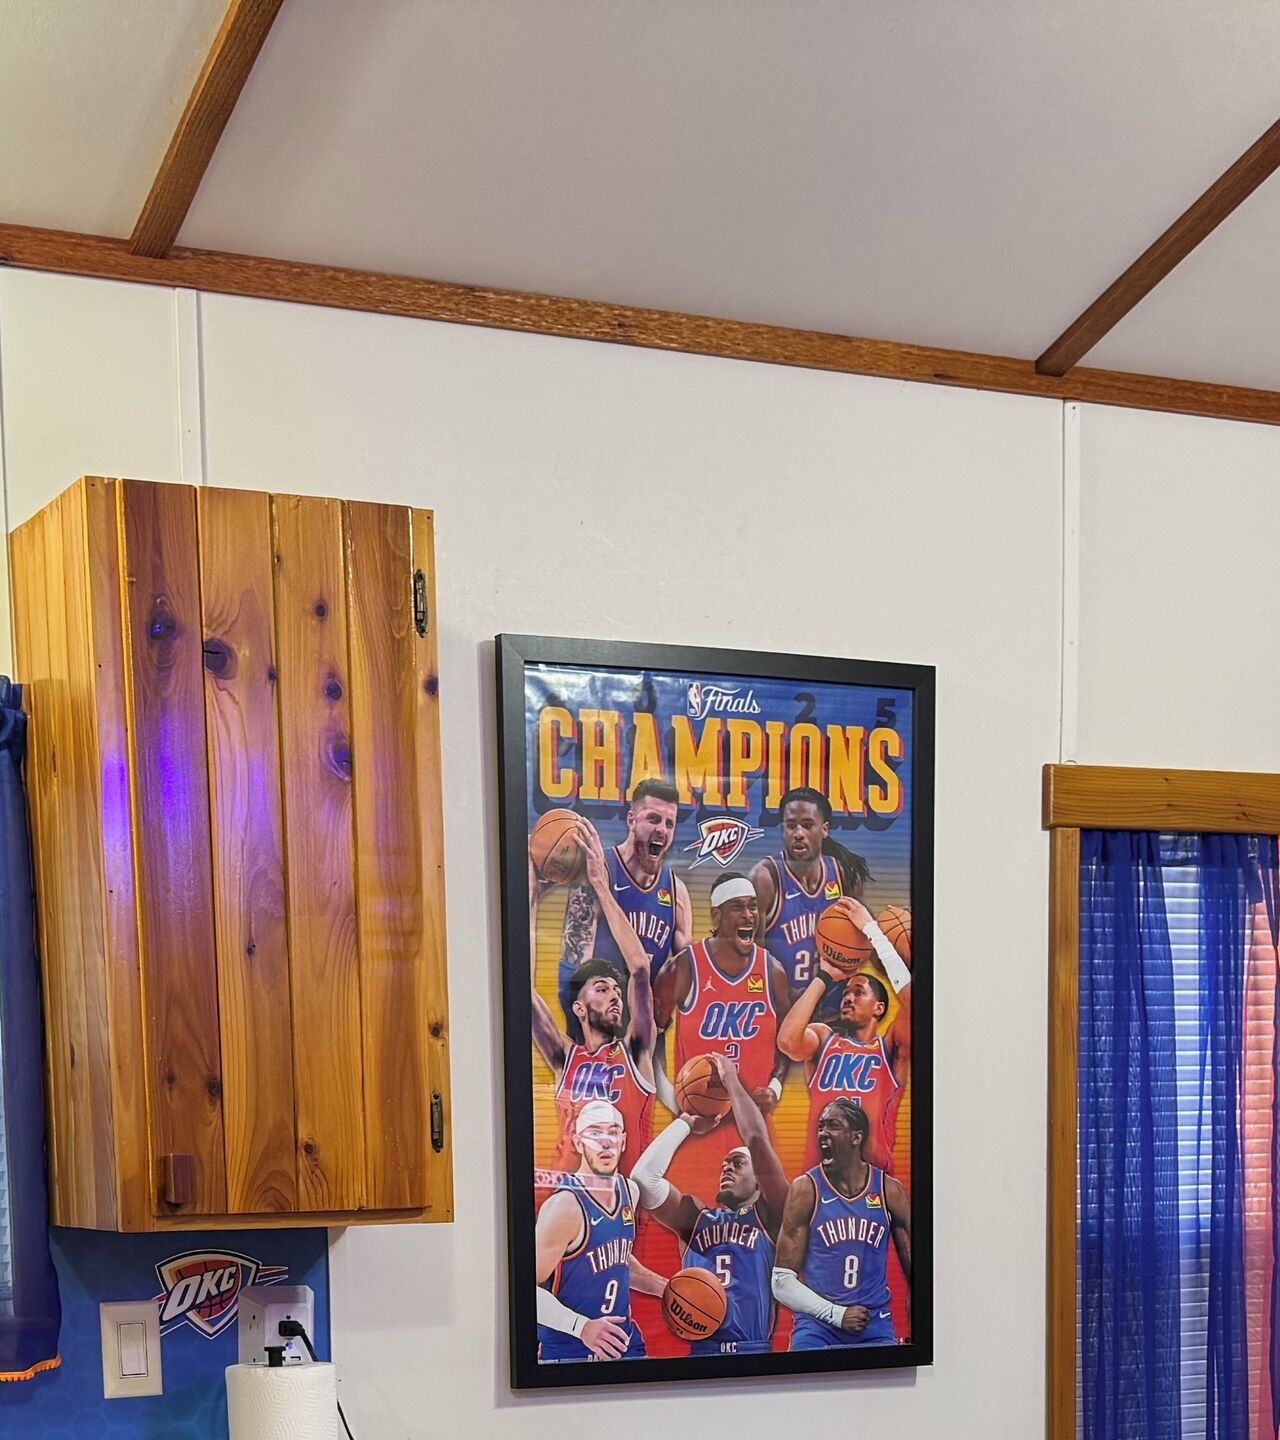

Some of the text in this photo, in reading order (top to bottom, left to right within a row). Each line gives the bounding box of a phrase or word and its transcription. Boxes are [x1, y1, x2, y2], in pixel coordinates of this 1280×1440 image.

[695, 685, 761, 722] Finals
[539, 705, 904, 816] CHAMPIONS
[699, 826, 738, 857] OKC
[629, 911, 671, 949] UNDER
[781, 912, 817, 945] THUN
[822, 942, 860, 966] Wilson
[699, 1000, 766, 1040] OKC
[571, 1061, 626, 1104] OKC
[818, 1053, 882, 1092] OKC
[695, 1222, 760, 1252] THUNDER
[817, 1217, 885, 1249] THUNDER
[843, 1254, 859, 1289] 8
[162, 1265, 238, 1322] OKC
[601, 1279, 619, 1315] 9
[670, 1298, 708, 1333] Wilson
